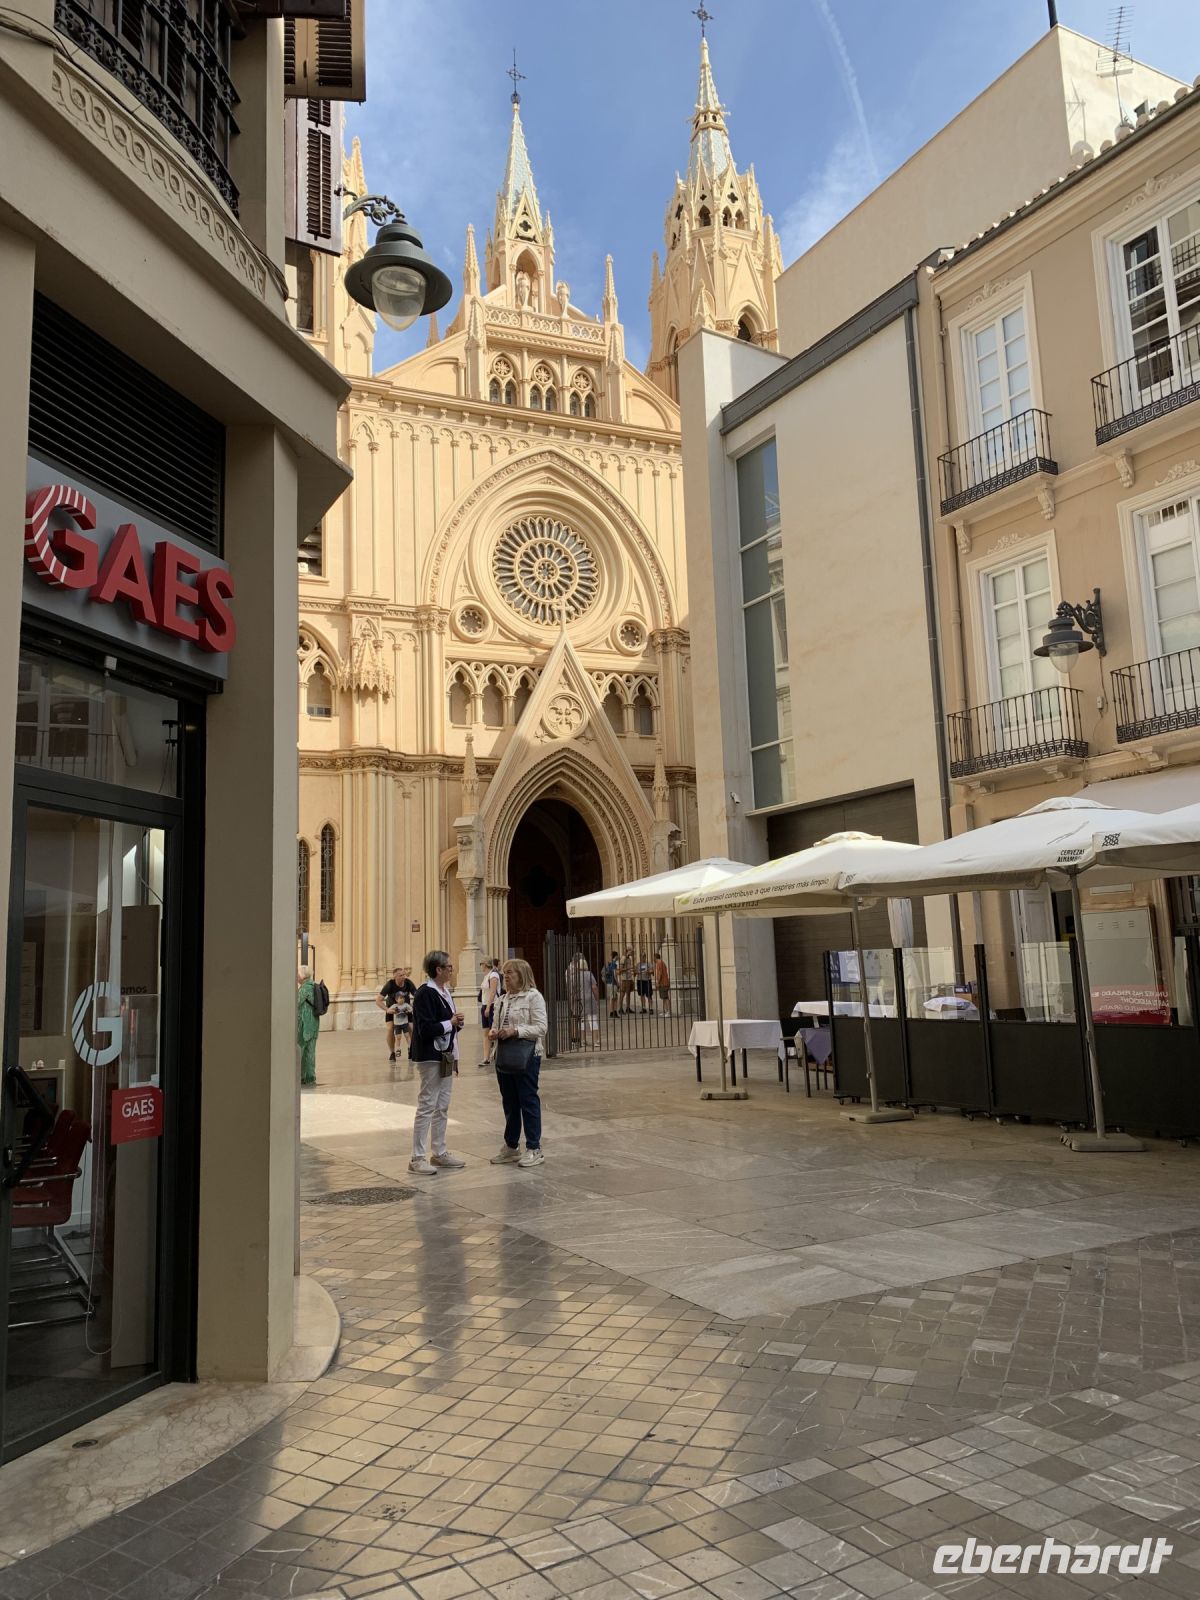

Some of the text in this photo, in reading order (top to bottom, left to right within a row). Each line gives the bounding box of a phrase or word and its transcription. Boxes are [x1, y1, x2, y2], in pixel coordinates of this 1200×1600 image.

[24, 485, 236, 653] GAES
[705, 892, 724, 903] parasol
[725, 888, 753, 899] contribuye
[760, 886, 771, 896] que
[772, 883, 796, 893] respires
[810, 877, 830, 887] limpio
[72, 981, 123, 1066] G
[121, 1098, 155, 1118] GAES
